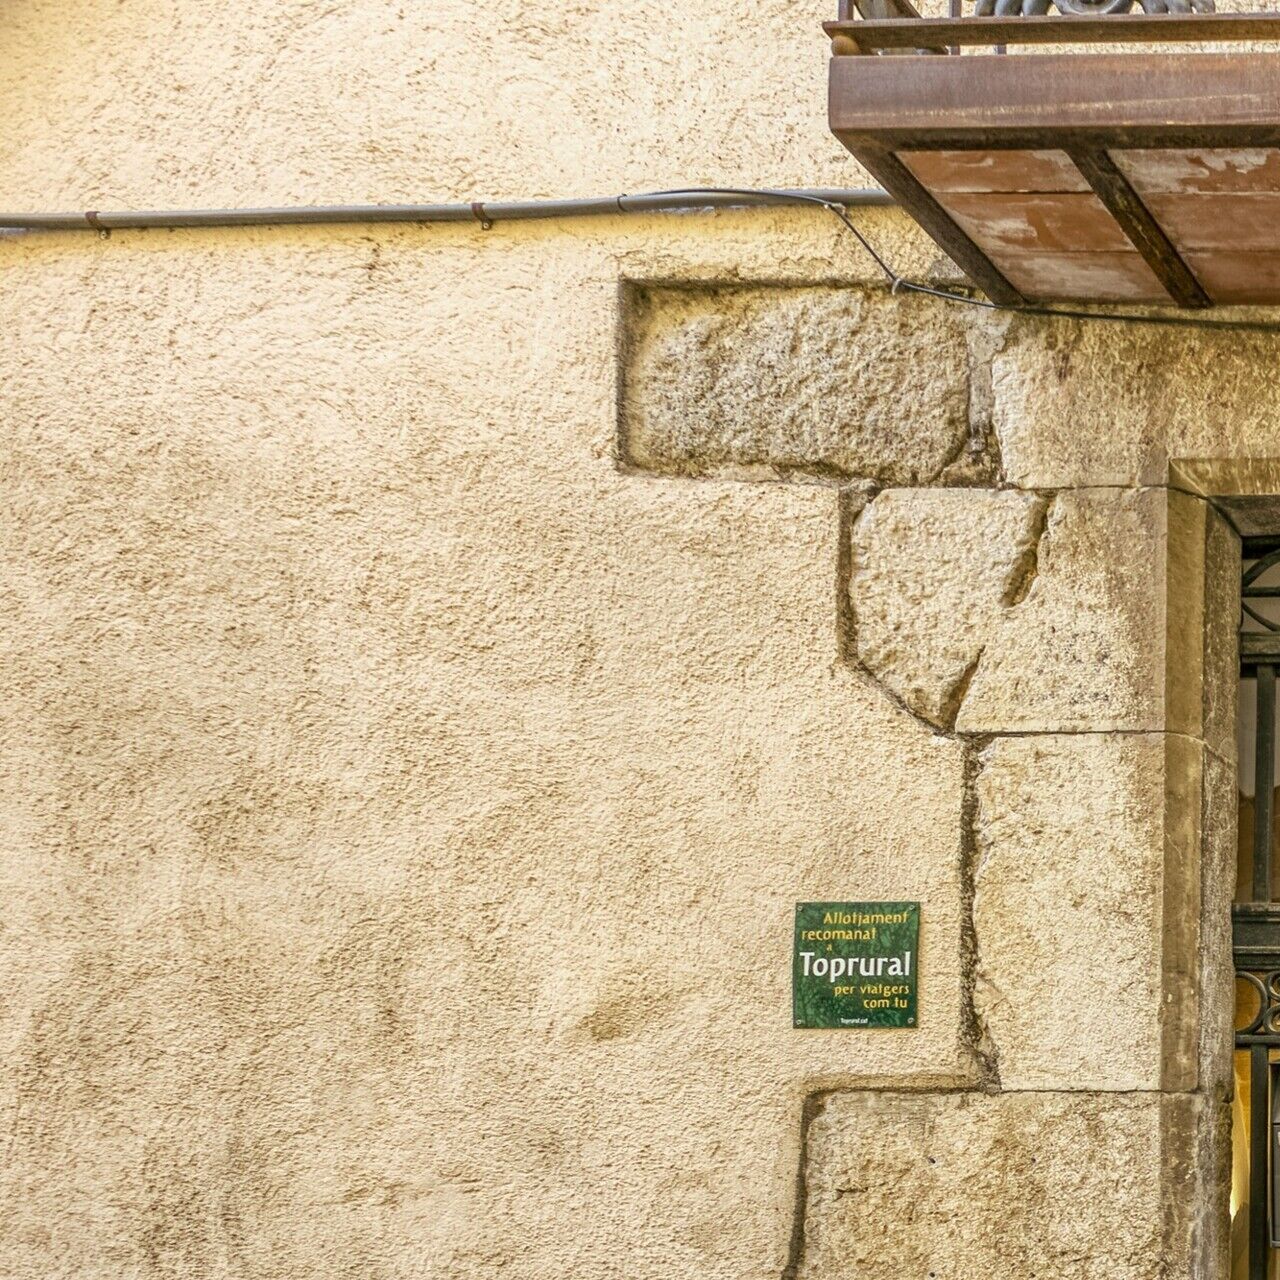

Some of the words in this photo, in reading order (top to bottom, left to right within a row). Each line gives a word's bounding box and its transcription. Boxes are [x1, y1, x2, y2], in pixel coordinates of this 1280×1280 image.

[823, 911, 909, 927] Allotjament
[801, 927, 877, 940] recomanat
[826, 944, 833, 952] a
[799, 951, 911, 983] Toprural
[834, 986, 855, 997] per
[860, 984, 910, 997] viatgers
[864, 998, 890, 1008] com
[895, 997, 908, 1008] tu
